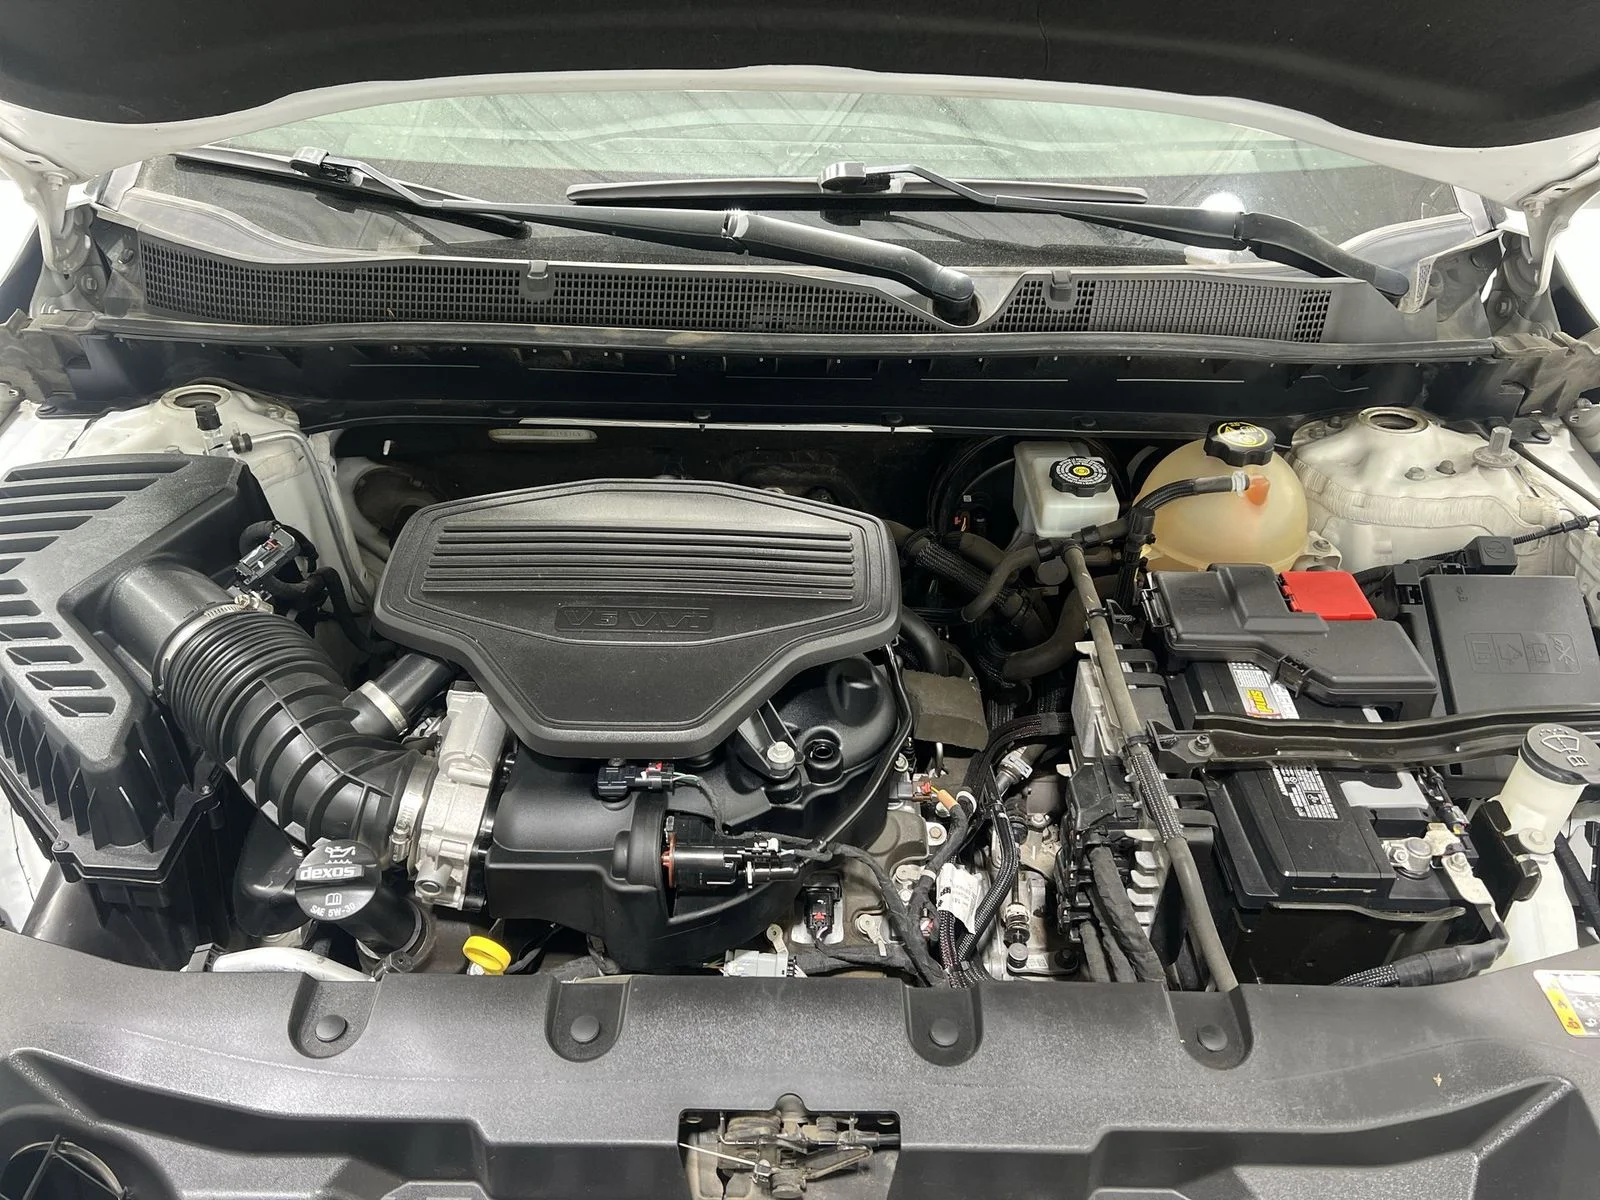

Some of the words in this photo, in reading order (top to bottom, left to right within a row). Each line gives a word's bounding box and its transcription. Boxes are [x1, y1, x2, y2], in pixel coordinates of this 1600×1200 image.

[564, 610, 618, 626] V6
[301, 867, 355, 880] dexos
[311, 904, 325, 917] SAE
[328, 903, 355, 917] 5W-30
